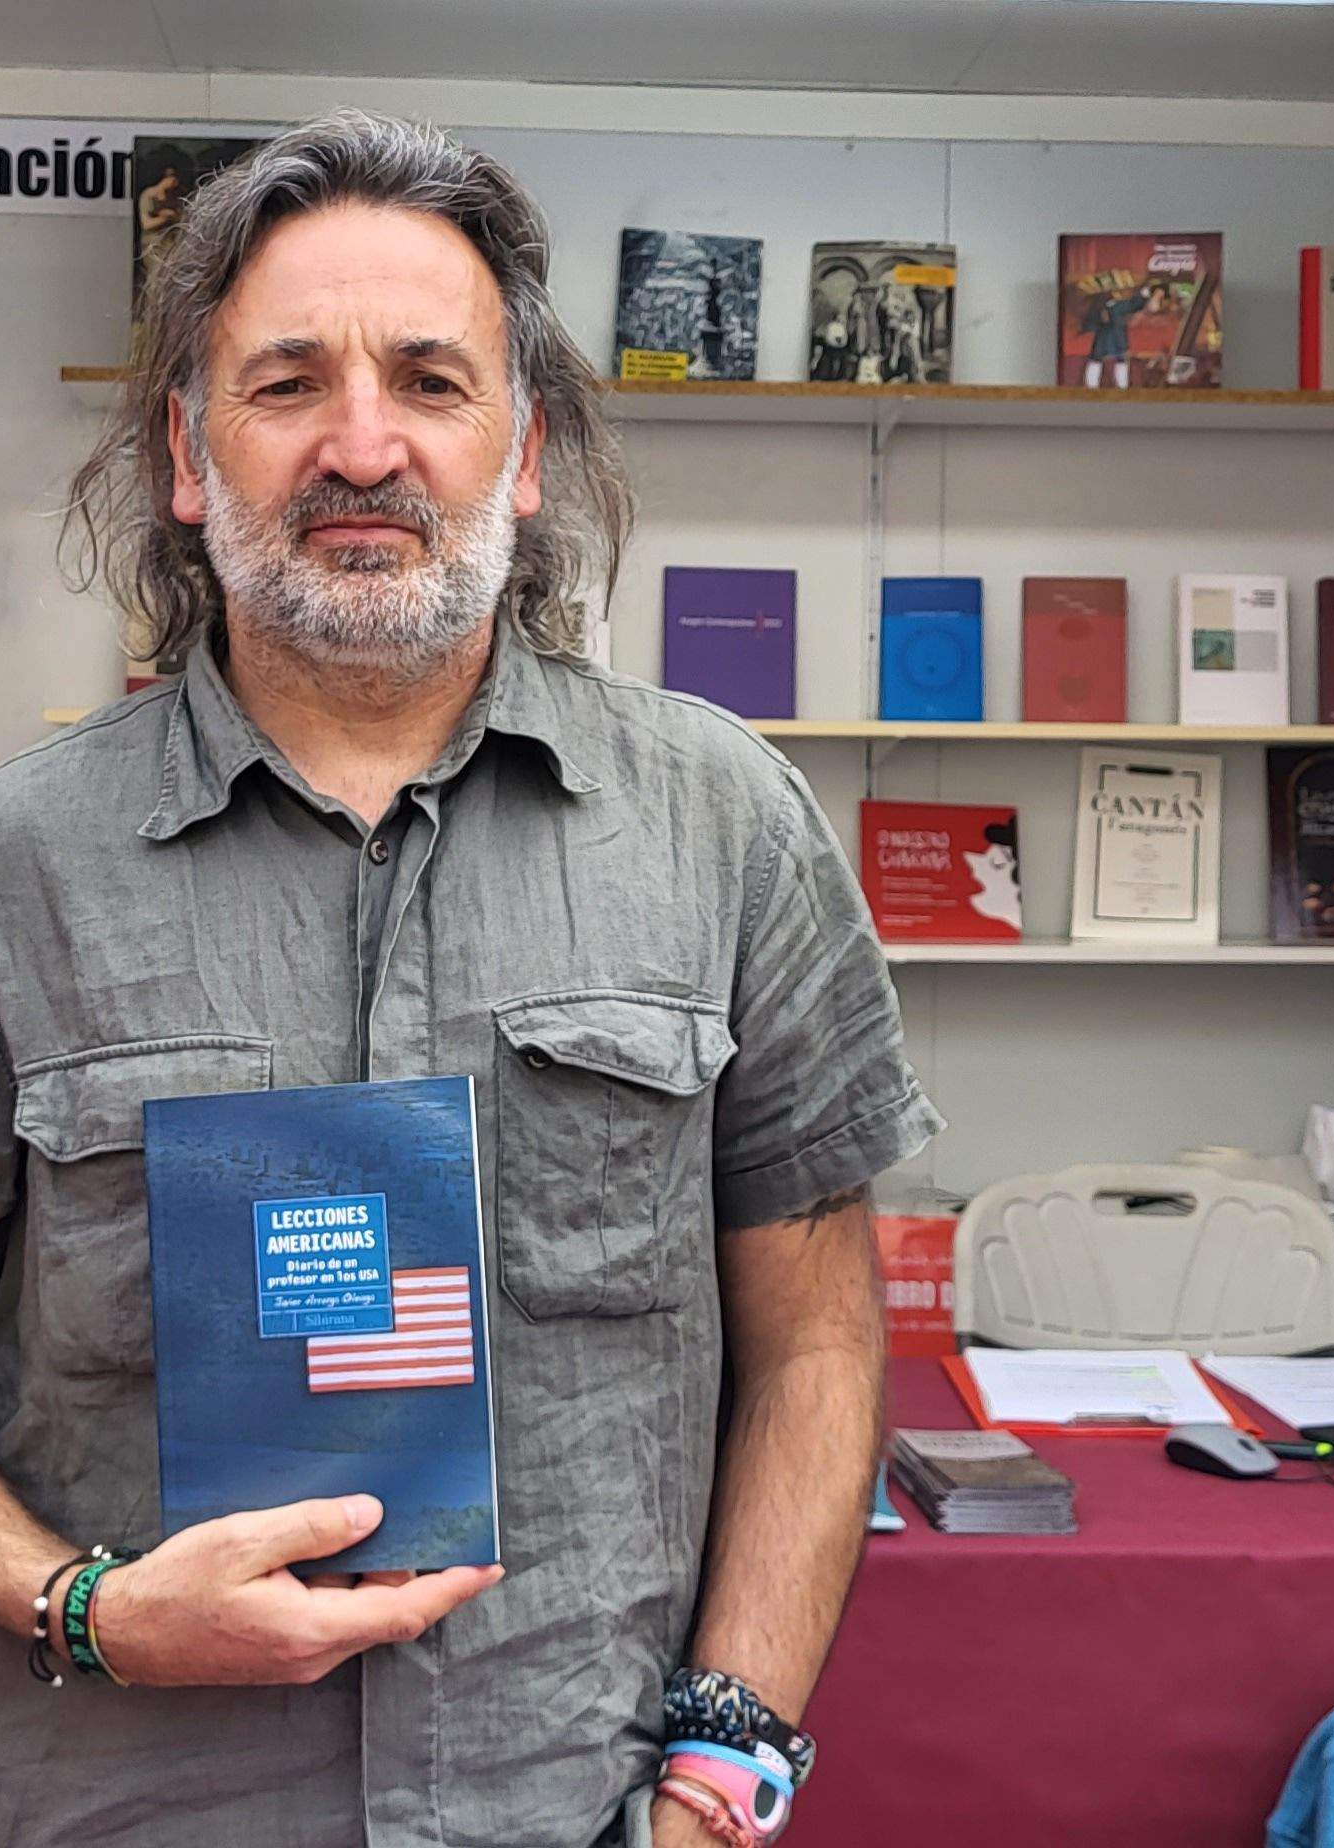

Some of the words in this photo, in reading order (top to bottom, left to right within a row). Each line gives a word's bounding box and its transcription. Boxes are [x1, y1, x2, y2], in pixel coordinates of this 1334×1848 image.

[271, 1205, 369, 1230] LECCIONES
[266, 1230, 375, 1255] AMERICANAS
[286, 1259, 326, 1273] Diario
[327, 1257, 342, 1269] de
[344, 1258, 358, 1268] un
[267, 1273, 319, 1290] profesor
[320, 1273, 335, 1284] en
[336, 1270, 357, 1282] los
[358, 1268, 379, 1281] USA
